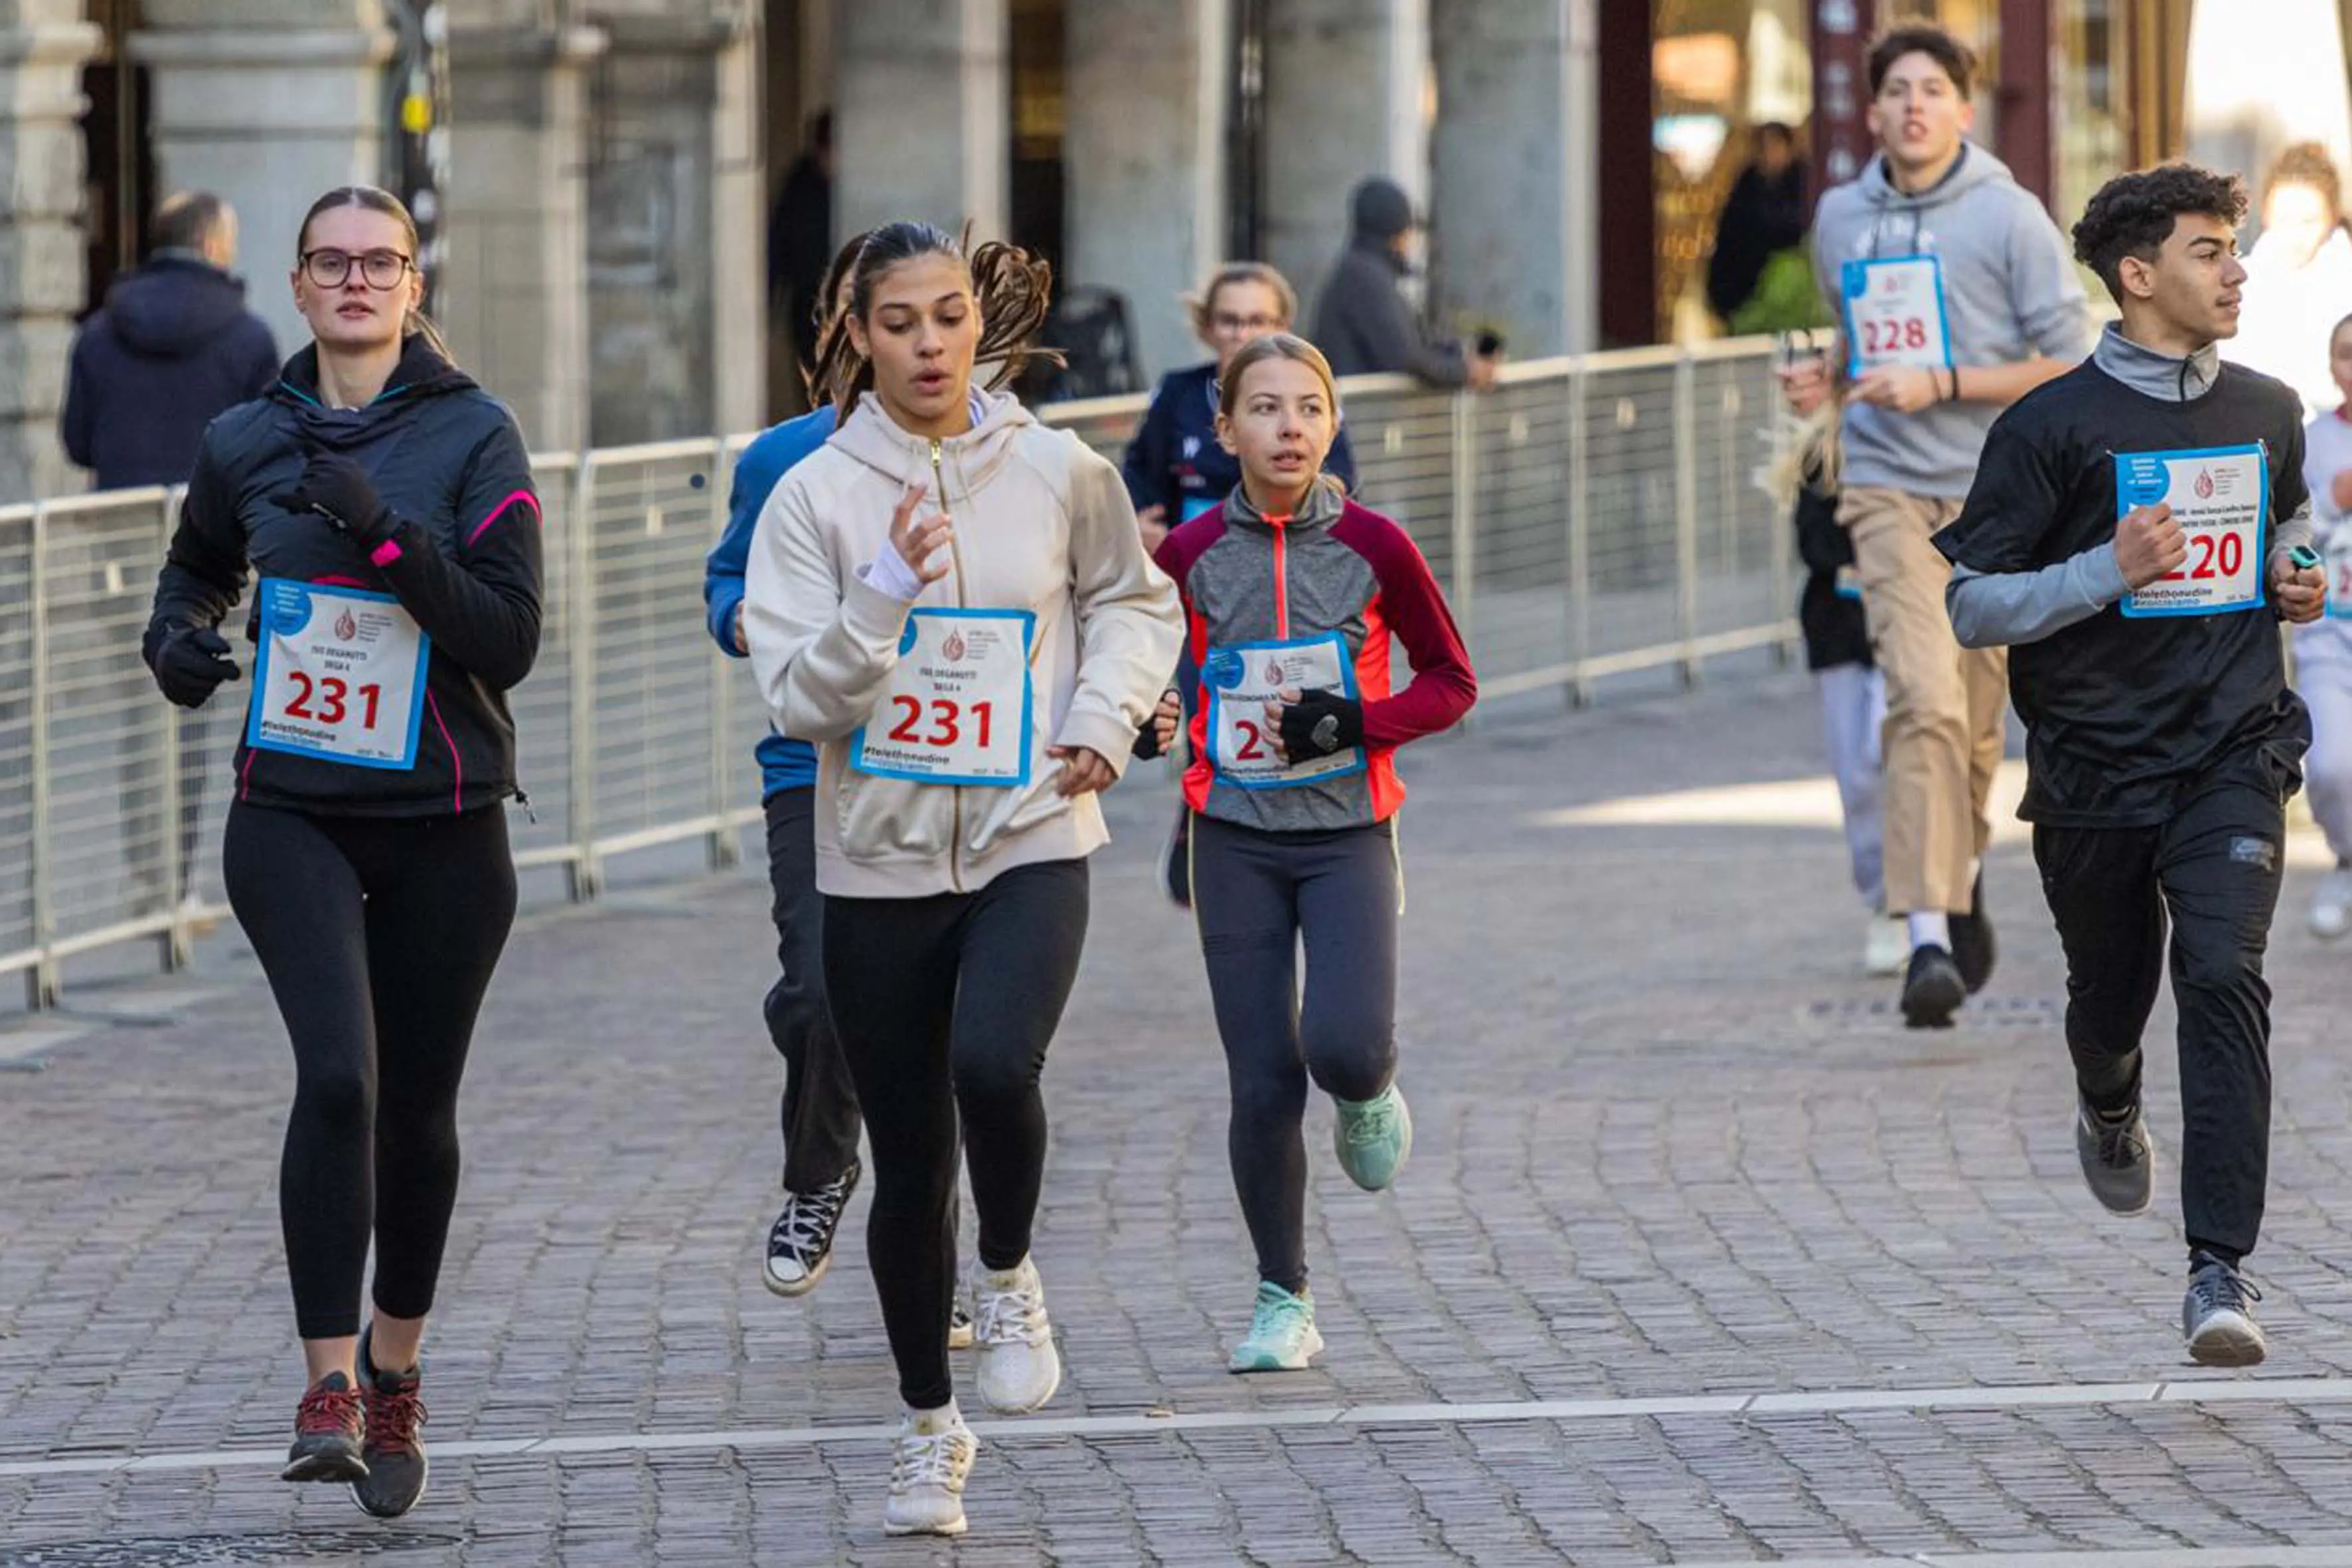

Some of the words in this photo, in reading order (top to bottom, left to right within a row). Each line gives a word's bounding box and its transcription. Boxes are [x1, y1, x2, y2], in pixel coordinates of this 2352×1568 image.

[1864, 317, 1926, 354] 228
[2157, 532, 2242, 582] 20
[284, 670, 381, 731] 231
[888, 694, 992, 748] 231
